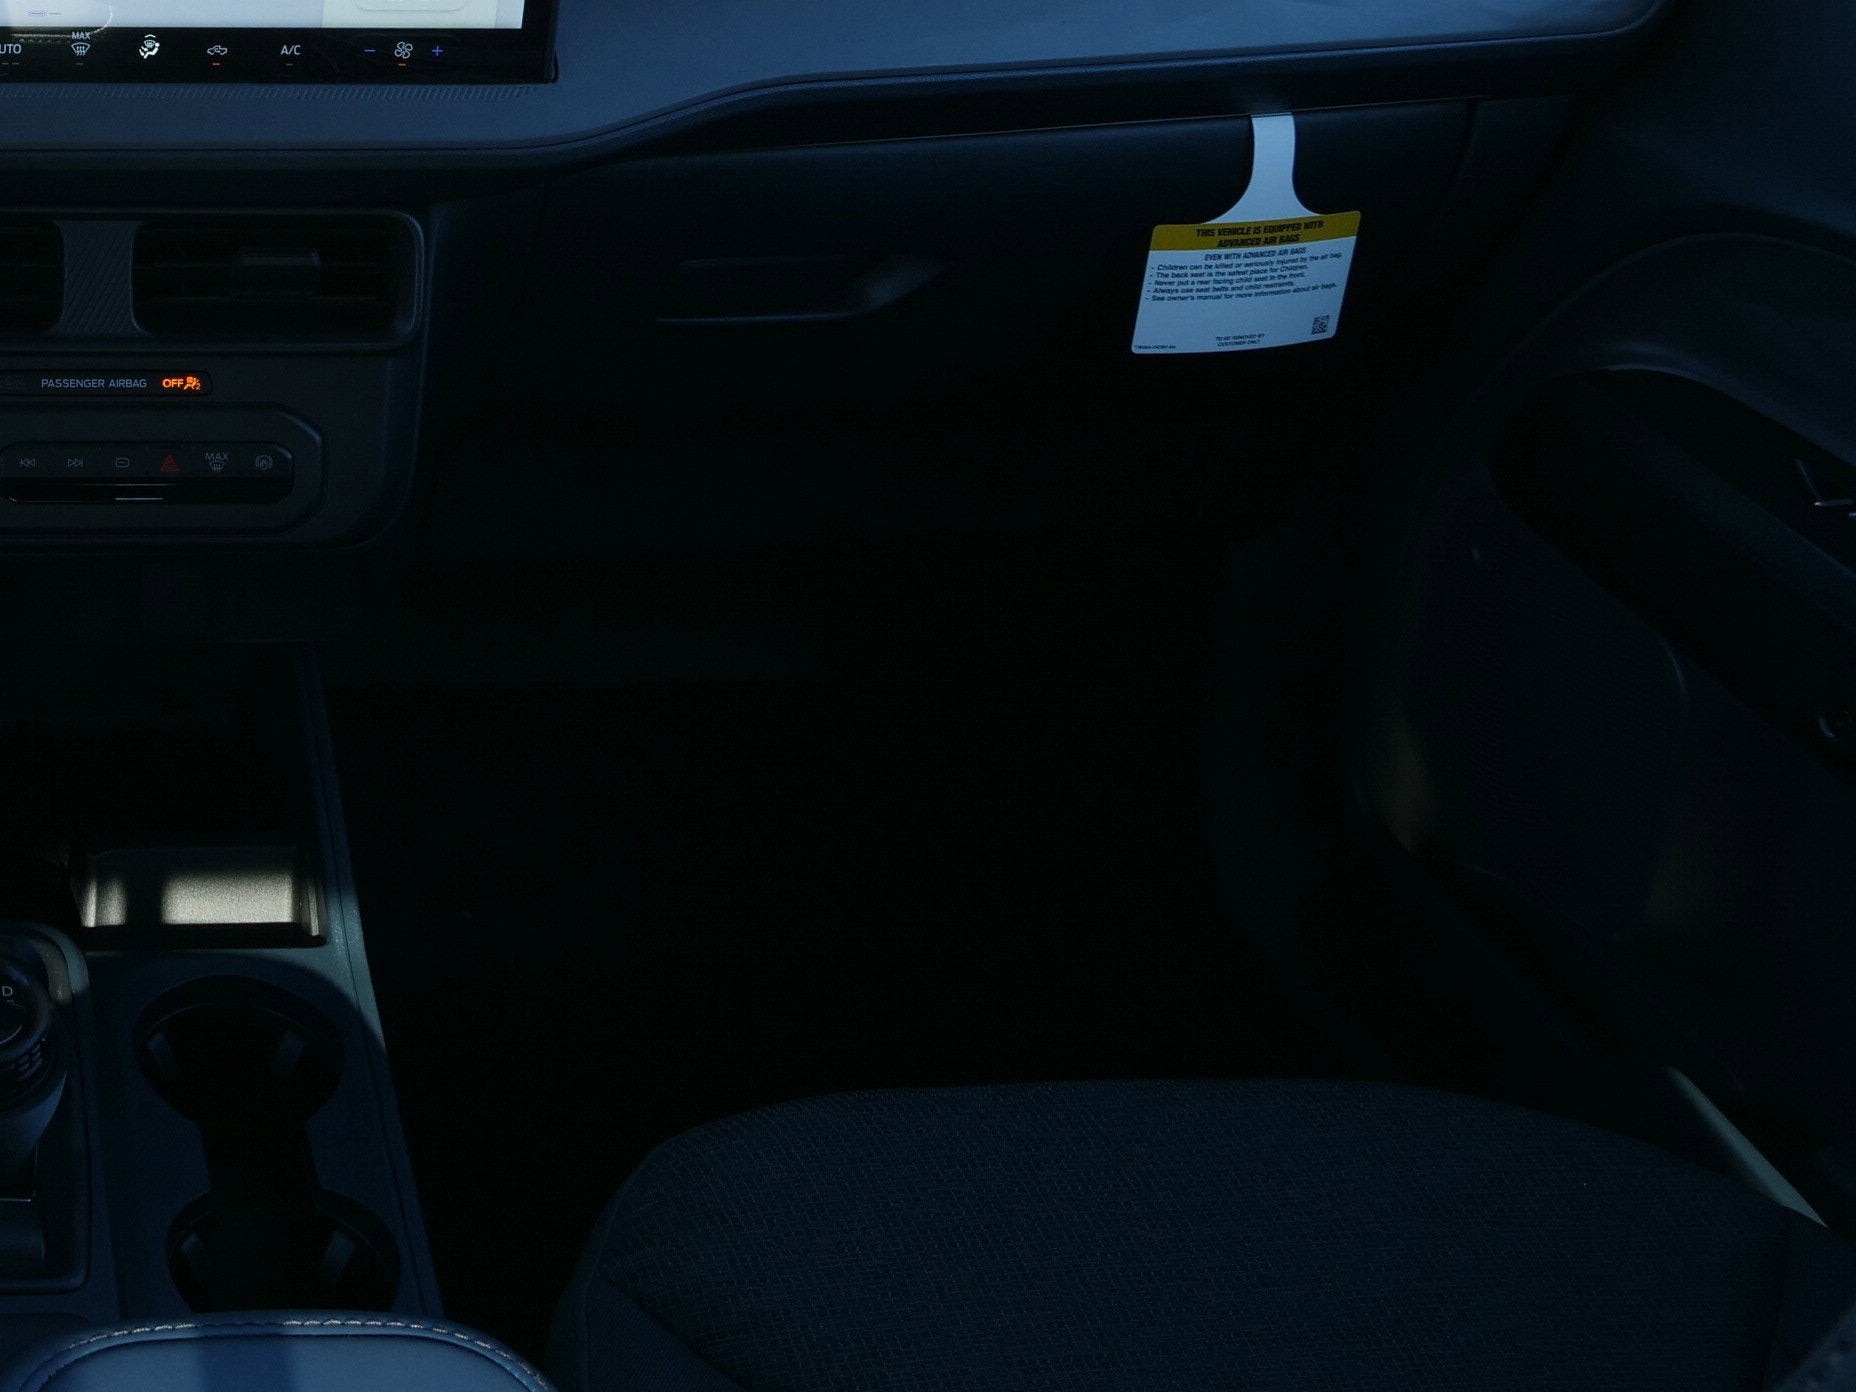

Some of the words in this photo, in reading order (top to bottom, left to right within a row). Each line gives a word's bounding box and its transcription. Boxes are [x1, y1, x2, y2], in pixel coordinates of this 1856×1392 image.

[71, 31, 91, 40] MAX
[280, 45, 301, 56] A/C
[1196, 228, 1215, 237] THIS
[1217, 226, 1251, 236] VEHICLE
[1254, 226, 1262, 235] IS
[1263, 222, 1302, 234] EQUIPPED
[1304, 220, 1324, 230] WITH
[1217, 237, 1262, 248] ADVANCED
[1263, 236, 1277, 245] AIR
[1279, 233, 1300, 243] BAGS
[1204, 253, 1222, 261] EVEN
[1224, 252, 1241, 260] WITH
[1243, 250, 1276, 259] ADVANCED
[1277, 248, 1289, 256] AIR
[1289, 246, 1307, 255] BAGS
[1249, 268, 1268, 276] place
[1177, 279, 1189, 287] put
[1212, 278, 1234, 286] facing
[1235, 276, 1252, 284] child
[1153, 287, 1179, 295] Always
[1254, 288, 1291, 297] information
[41, 378, 105, 388] PASSENGER
[108, 378, 148, 388] AIRBAG
[161, 378, 184, 388] OFF
[205, 452, 229, 460] MAX
[2, 986, 13, 996] D
